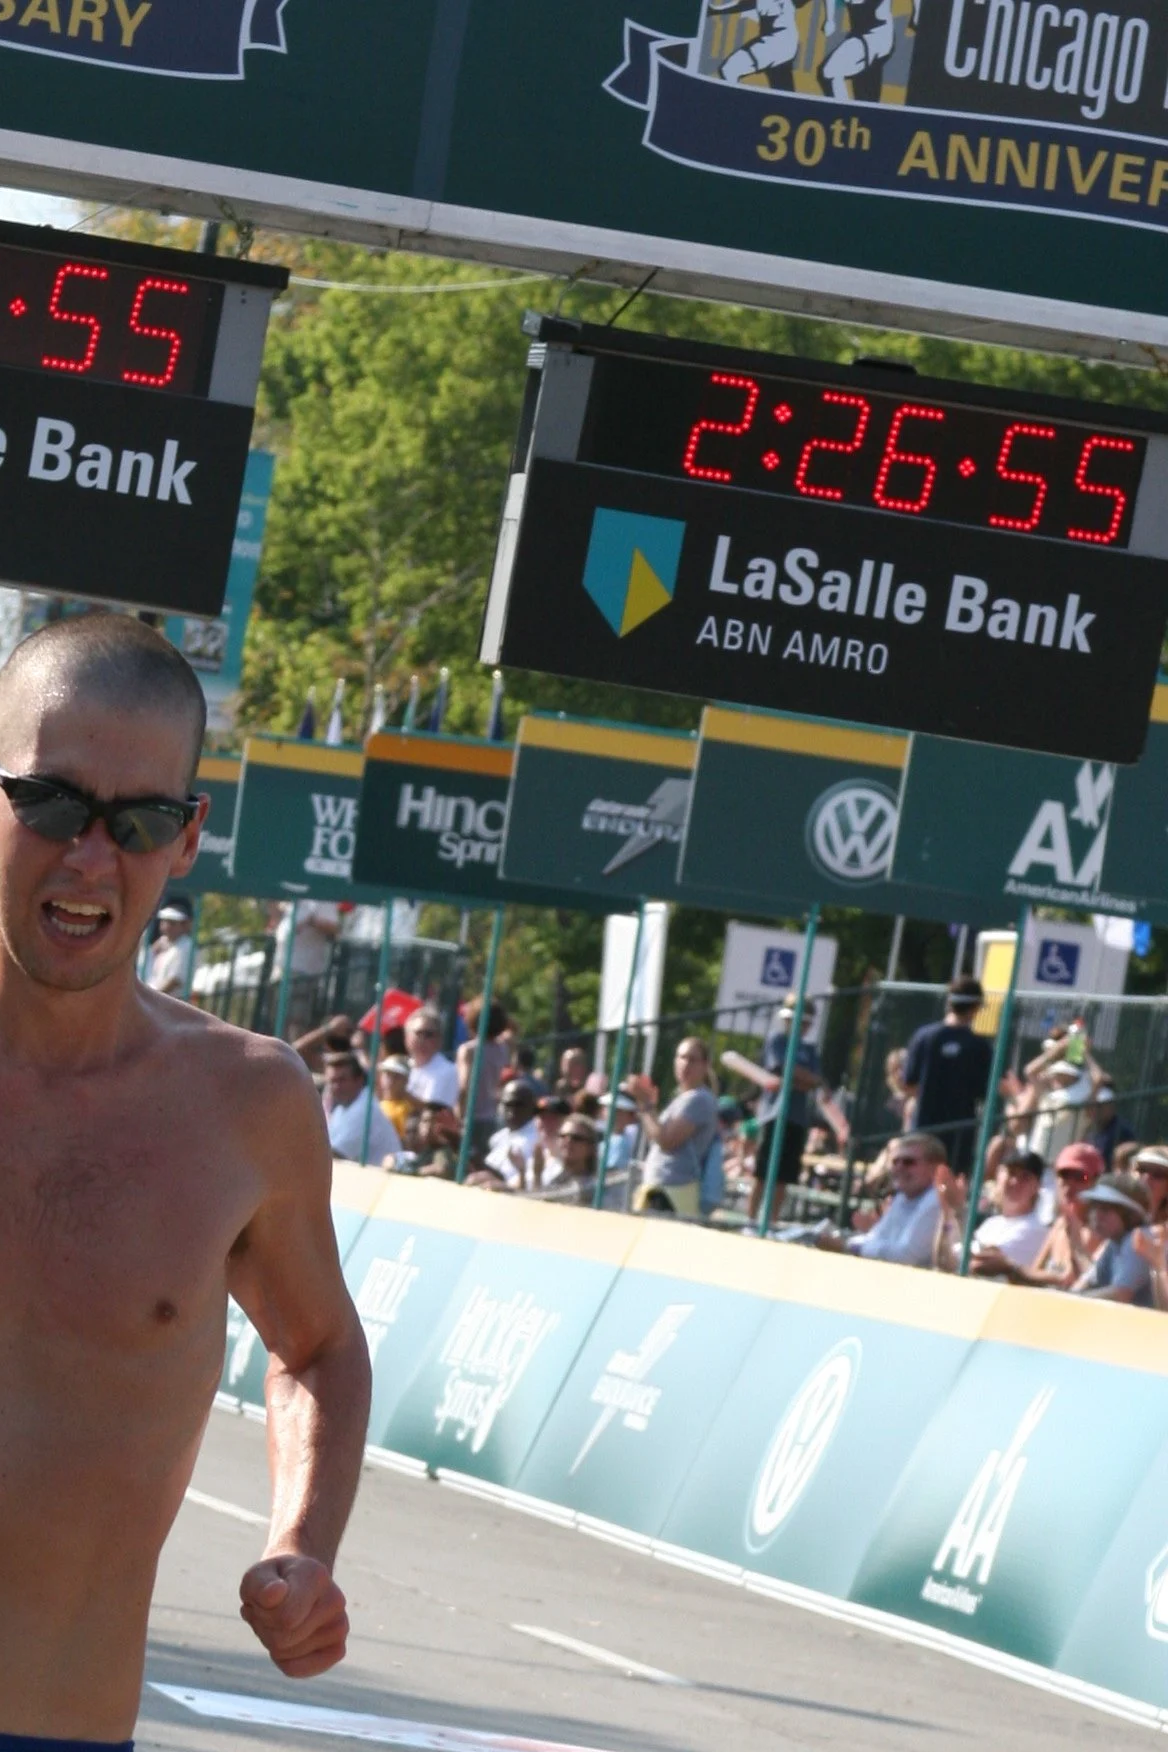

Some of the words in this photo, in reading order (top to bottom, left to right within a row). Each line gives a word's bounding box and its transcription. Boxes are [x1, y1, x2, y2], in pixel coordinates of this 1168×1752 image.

[944, 0, 1150, 120] Chicago
[755, 113, 872, 168] 30th
[27, 415, 198, 505] Bank
[708, 534, 930, 625] LaSalle
[943, 572, 1096, 654] Bank
[695, 614, 772, 655] ABN
[782, 631, 890, 676] AMRO
